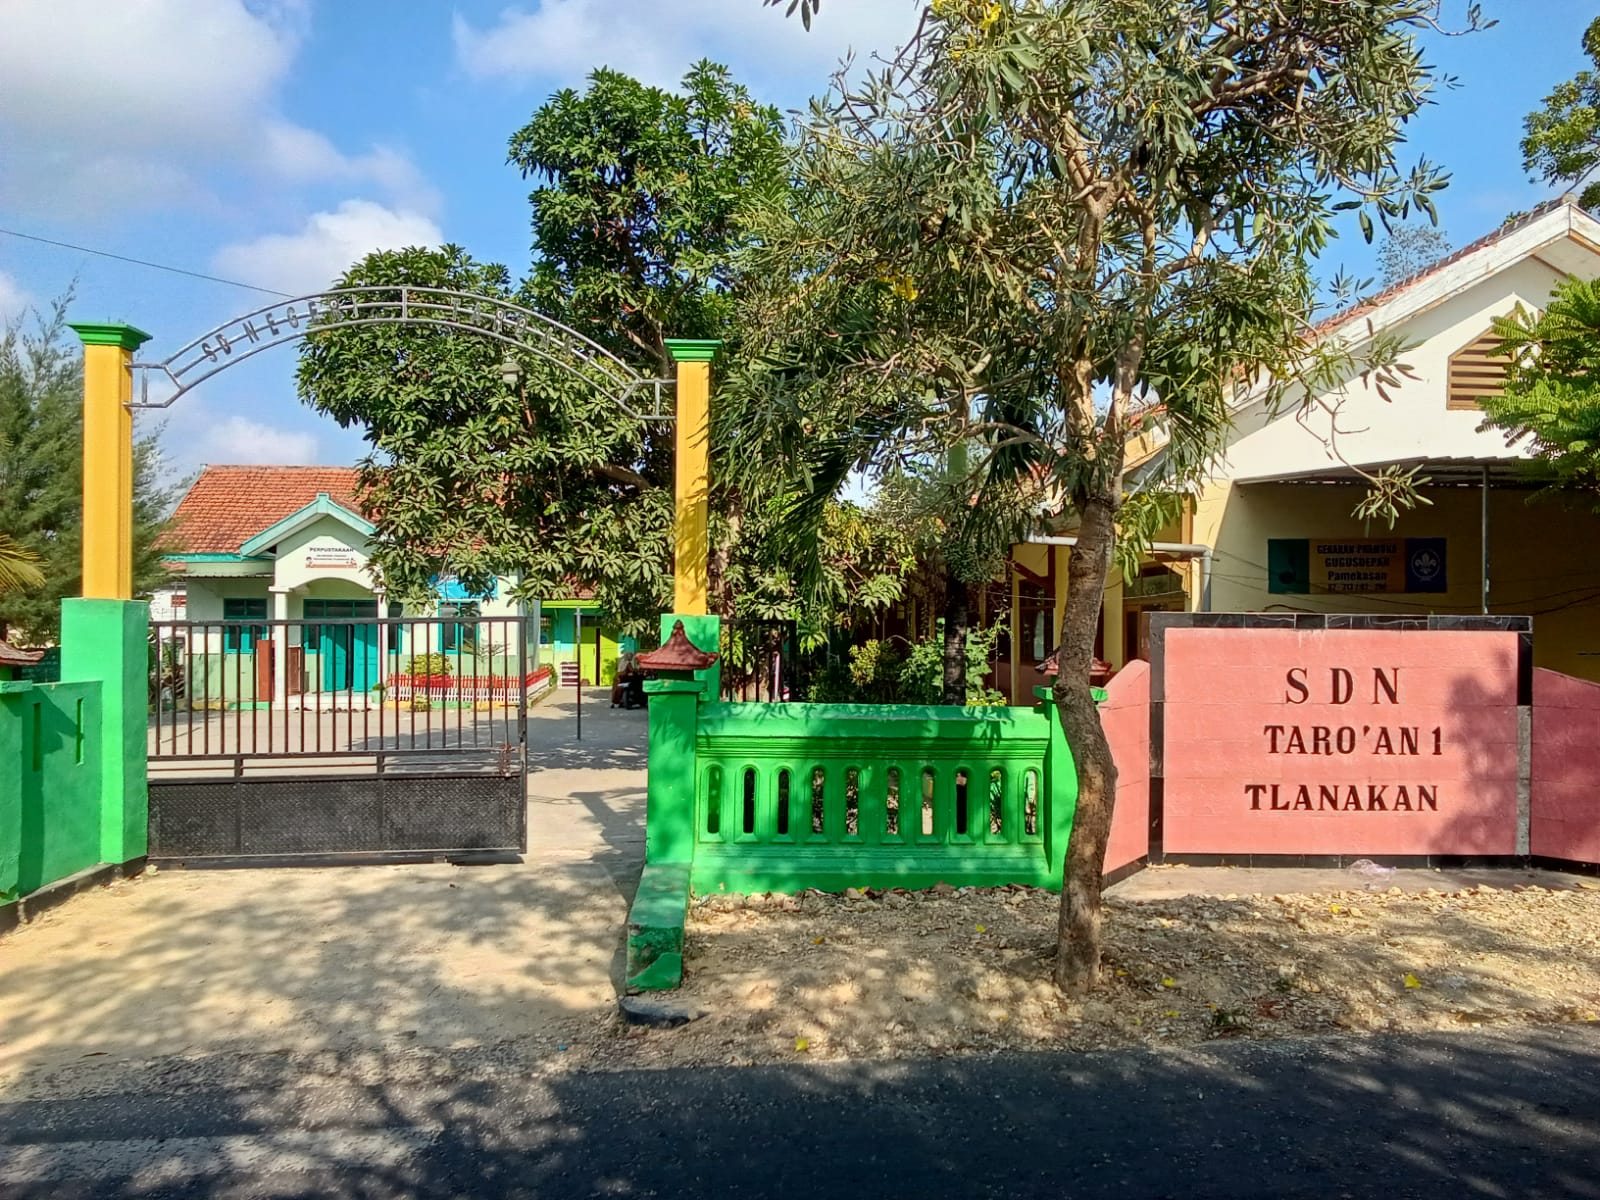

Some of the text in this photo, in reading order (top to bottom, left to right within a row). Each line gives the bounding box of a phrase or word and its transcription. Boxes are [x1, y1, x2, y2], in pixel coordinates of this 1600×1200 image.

[201, 333, 232, 363] SD
[1327, 571, 1388, 581] Pamekasan
[1263, 725, 1443, 756] TARO'AN 1
[1244, 784, 1439, 812] TLANAKAN
